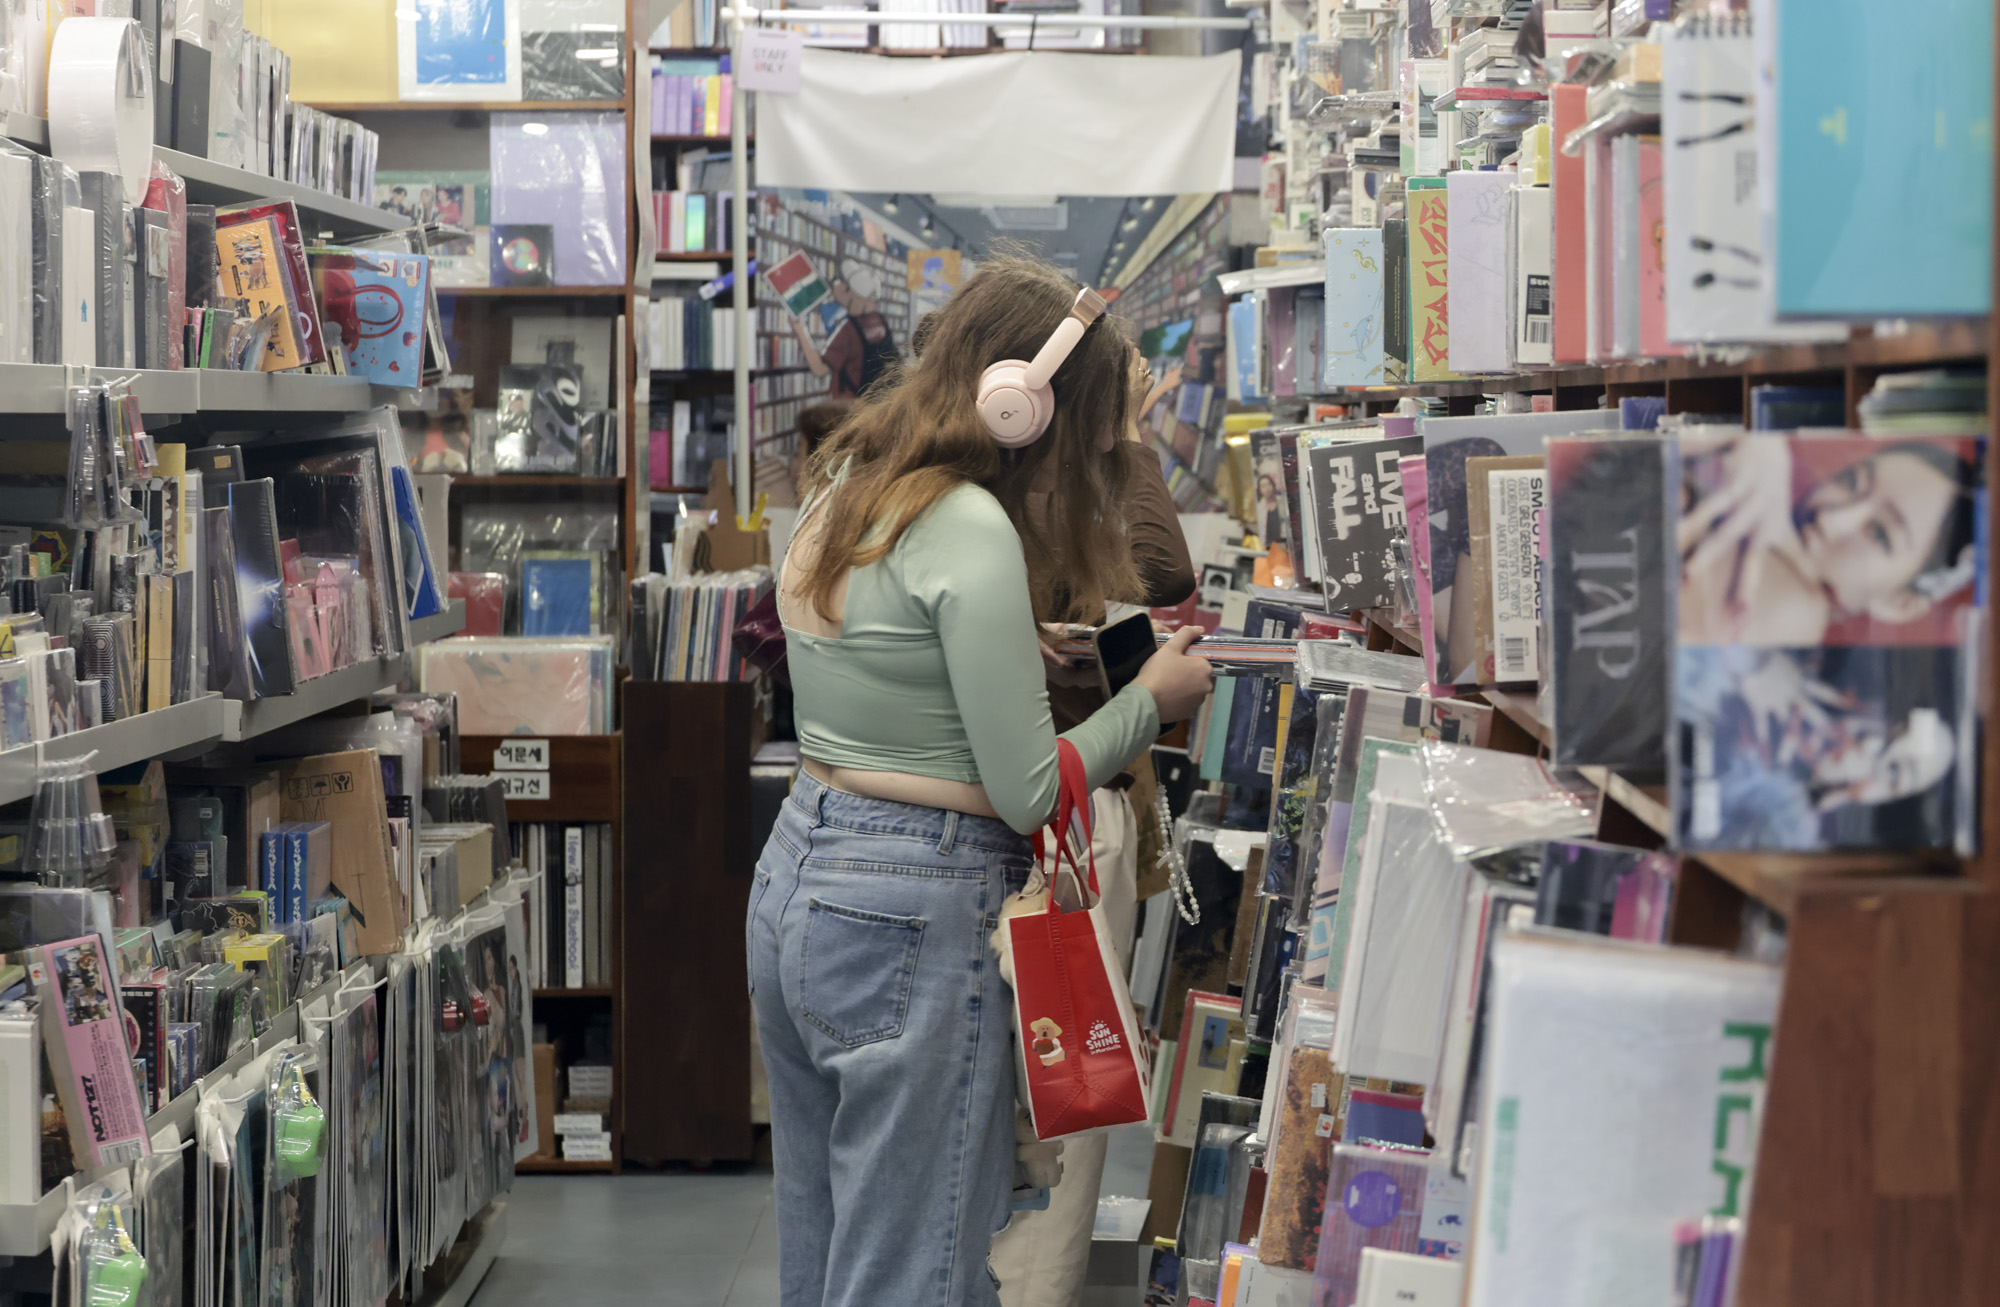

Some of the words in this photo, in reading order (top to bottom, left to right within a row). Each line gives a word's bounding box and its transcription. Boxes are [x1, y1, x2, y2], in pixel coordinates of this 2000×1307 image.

[753, 49, 787, 60] STAFF
[1329, 456, 1362, 541] FALL
[1360, 473, 1380, 515] and
[1375, 450, 1407, 530] LIVE
[1086, 1033, 1120, 1050] SHINE
[1089, 1028, 1111, 1040] SUN
